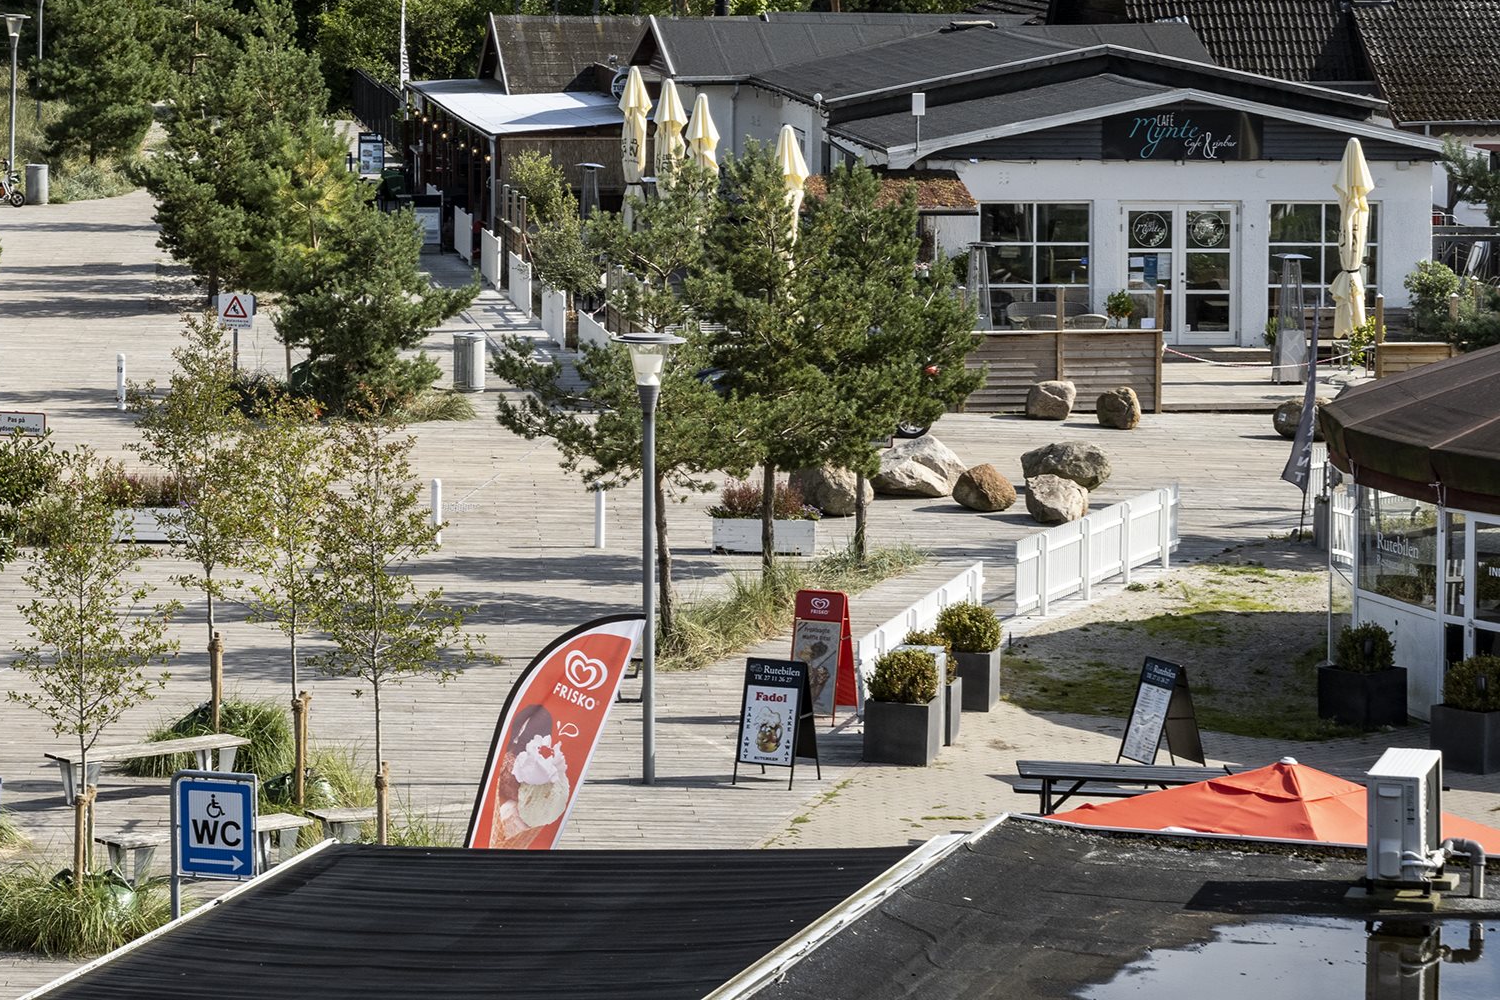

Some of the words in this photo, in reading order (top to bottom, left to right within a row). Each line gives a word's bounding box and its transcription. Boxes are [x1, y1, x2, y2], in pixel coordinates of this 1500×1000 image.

[1156, 112, 1175, 127] CAFÉ
[1129, 117, 1199, 159] Mynte
[1377, 531, 1419, 559] Rutebilen
[764, 664, 800, 677] Rutebilen
[552, 682, 595, 711] FRISKO
[191, 818, 242, 847] WC
